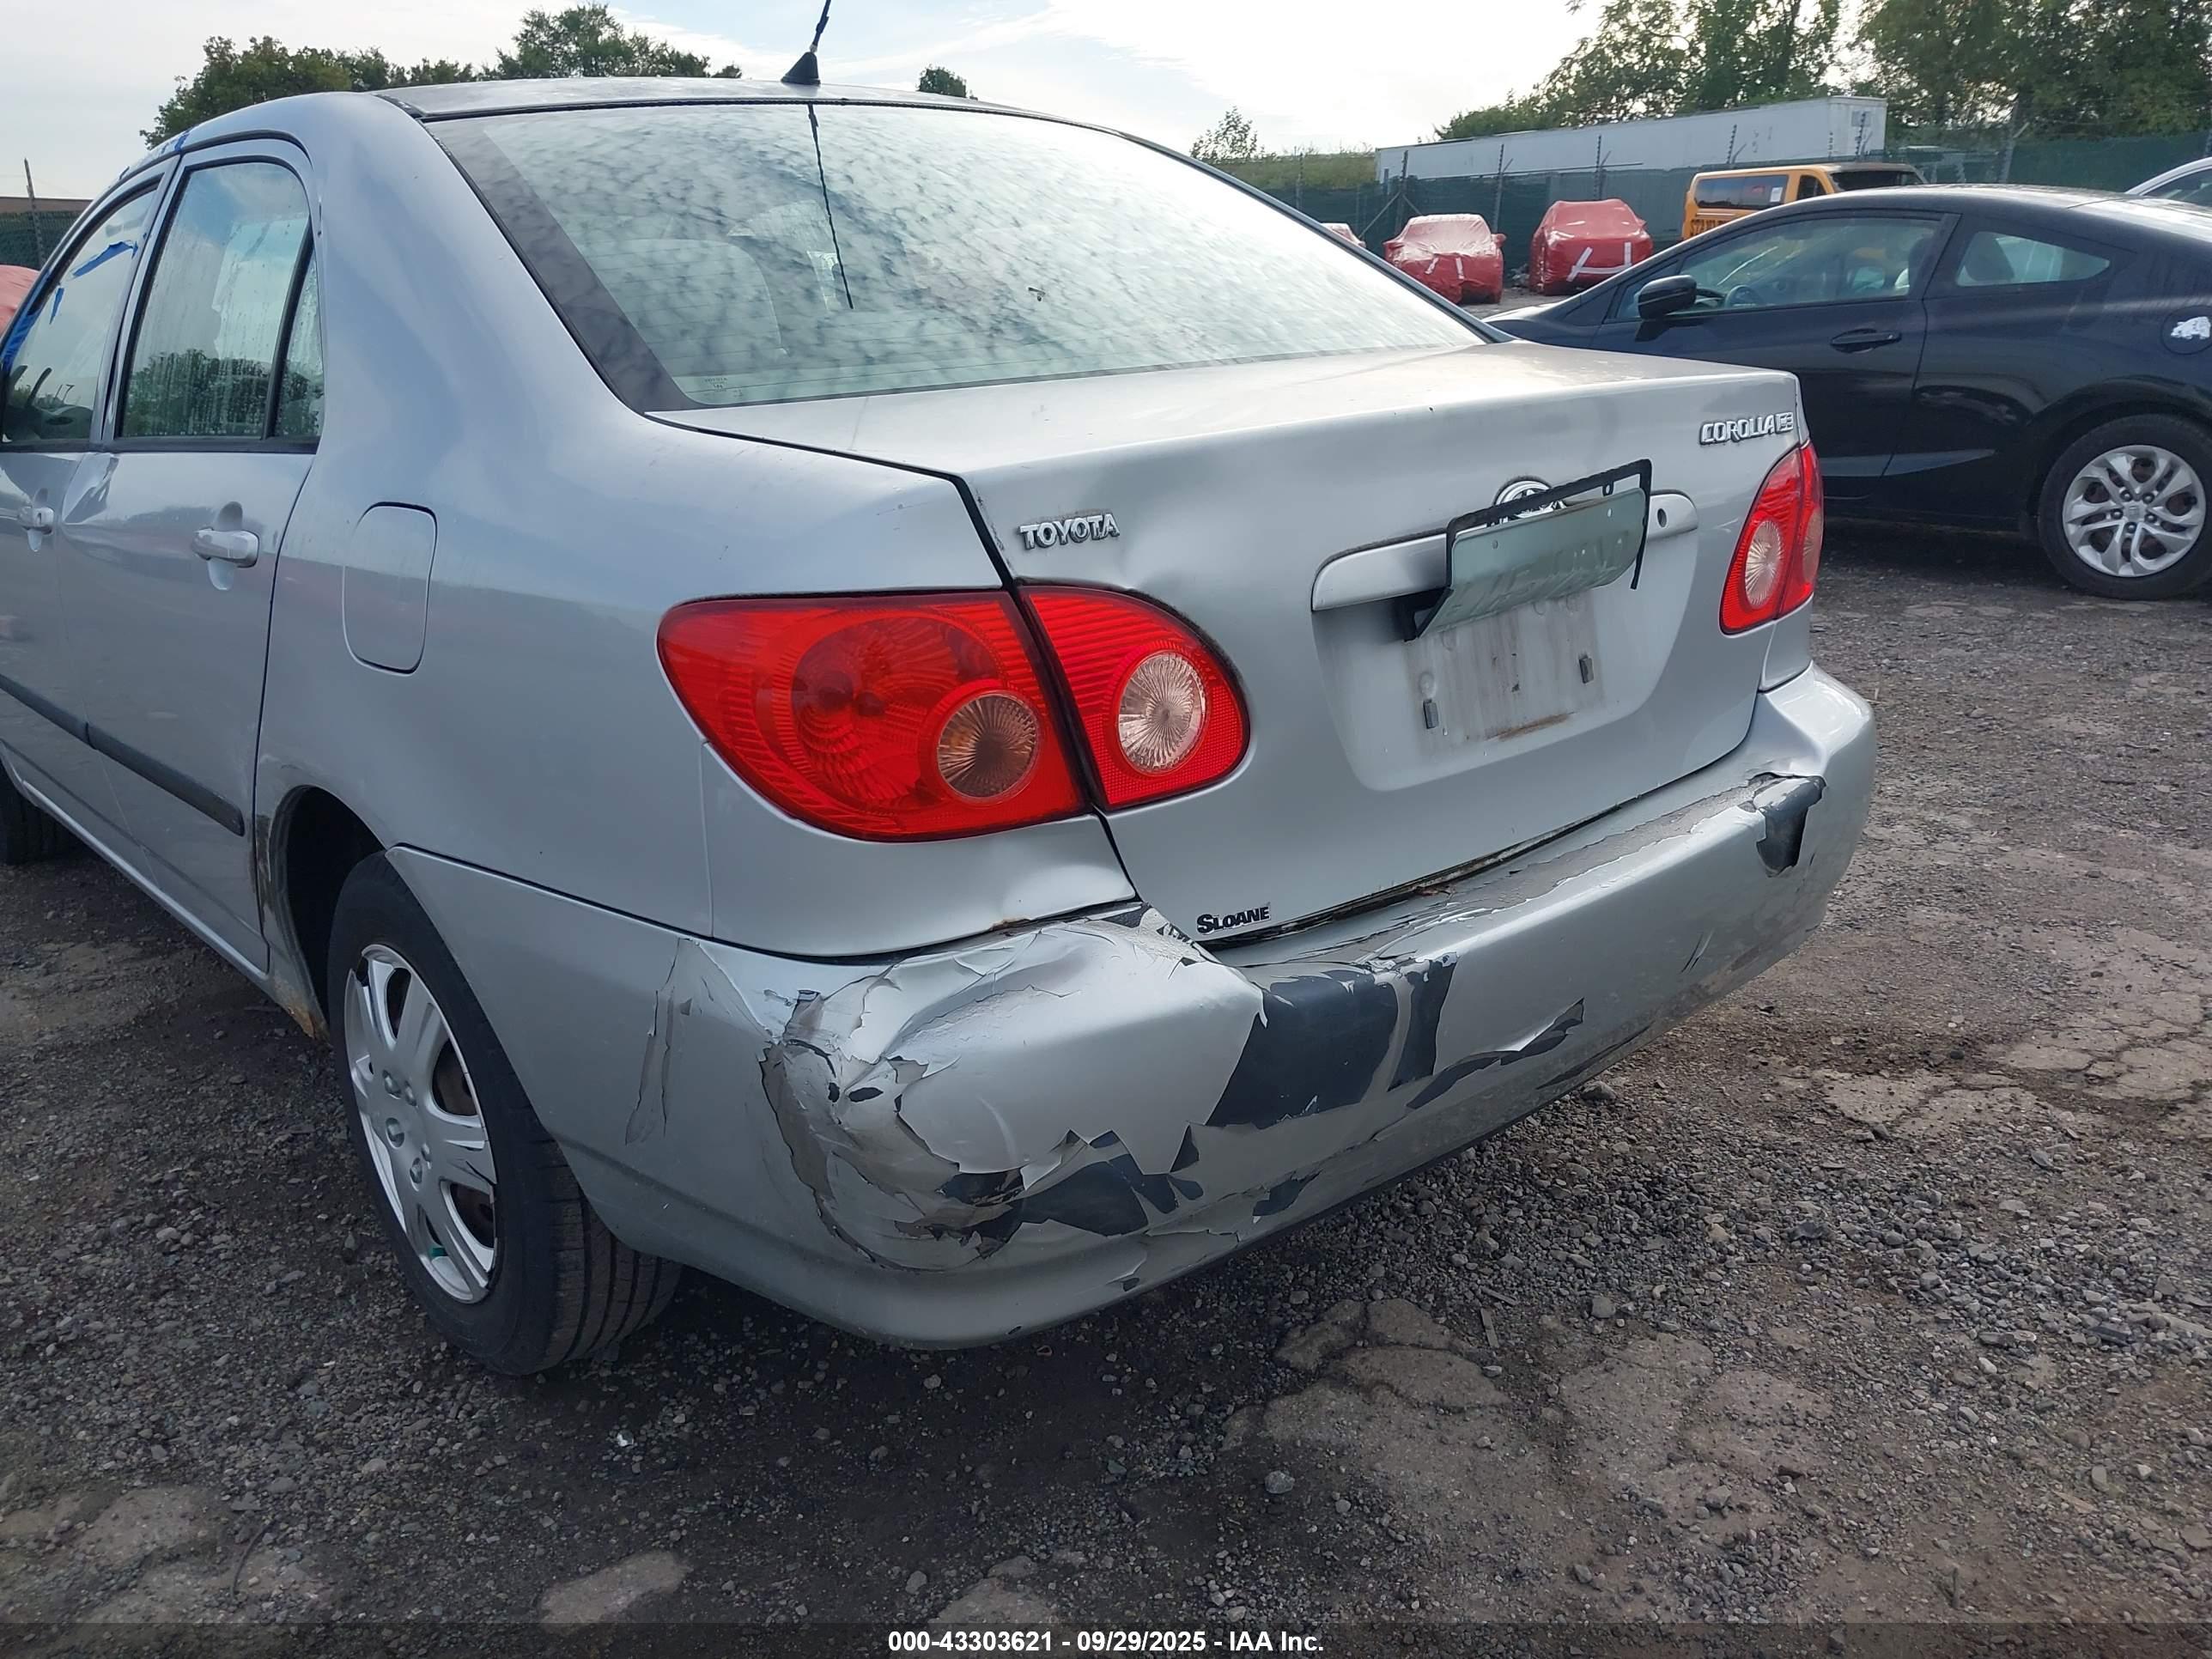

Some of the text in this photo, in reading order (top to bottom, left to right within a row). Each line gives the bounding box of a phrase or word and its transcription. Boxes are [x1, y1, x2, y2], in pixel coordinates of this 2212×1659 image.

[1699, 414, 1775, 445] COROLLA
[1018, 513, 1120, 550] TOYOTA
[1196, 906, 1271, 934] SLOANE
